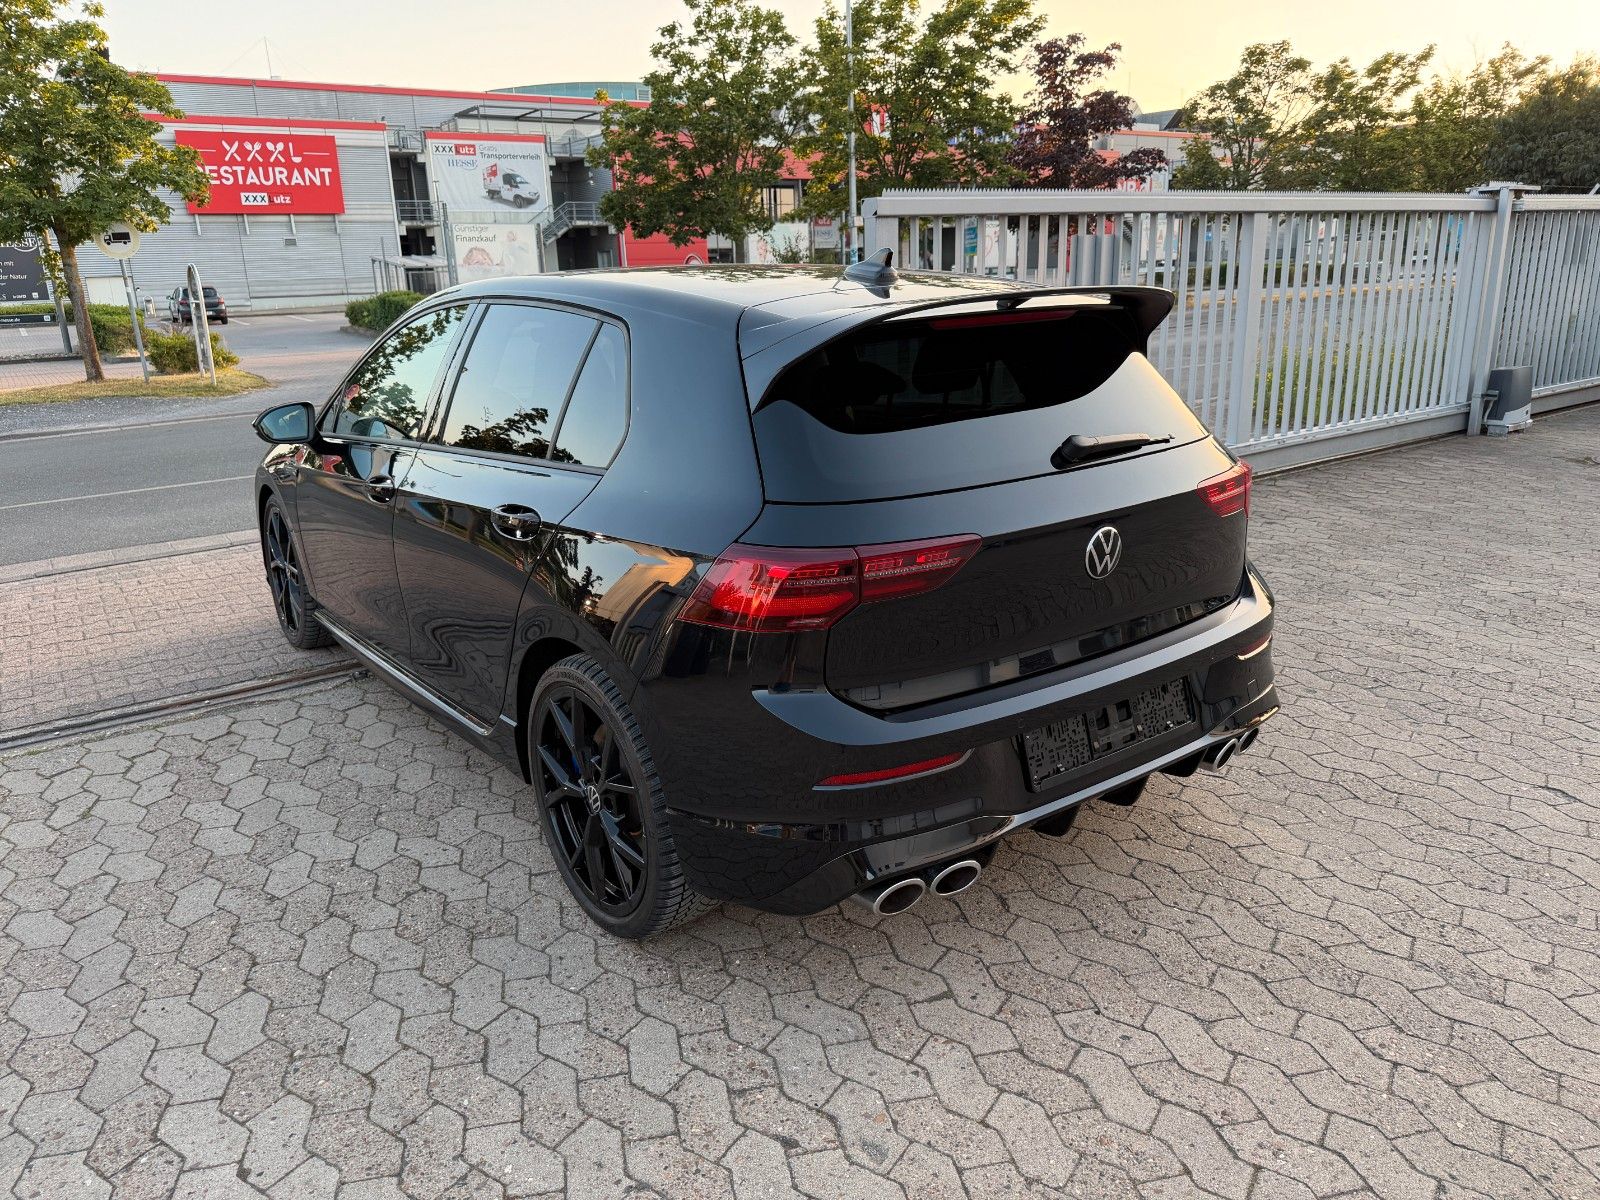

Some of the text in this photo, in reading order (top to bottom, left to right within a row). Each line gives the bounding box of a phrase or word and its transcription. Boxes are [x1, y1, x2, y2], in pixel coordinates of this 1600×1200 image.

[480, 151, 541, 160] Transporterverleih
[455, 234, 497, 242] Finanzkauf
[9, 272, 28, 280] Natur
